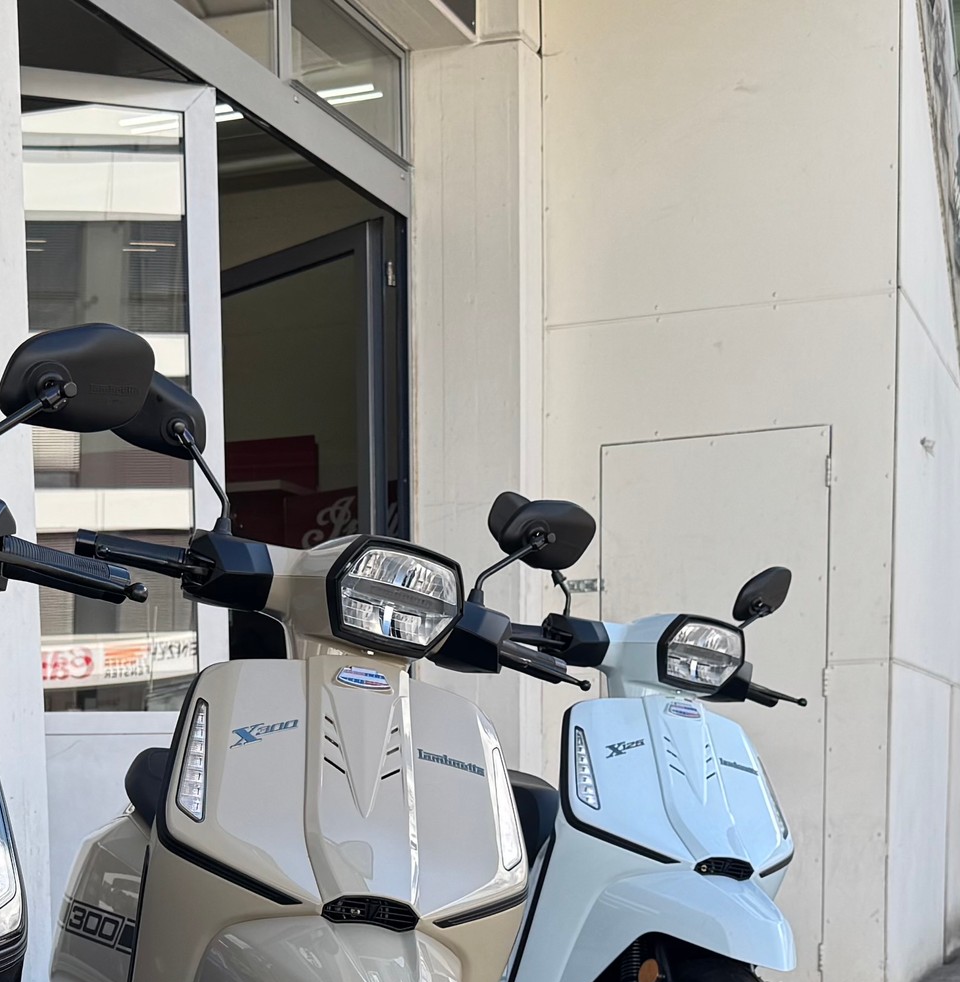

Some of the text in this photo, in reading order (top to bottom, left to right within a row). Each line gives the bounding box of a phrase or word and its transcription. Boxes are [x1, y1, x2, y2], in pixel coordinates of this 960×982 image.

[230, 719, 298, 749] X300
[417, 749, 485, 777] Lambretta
[69, 906, 120, 942] 300
